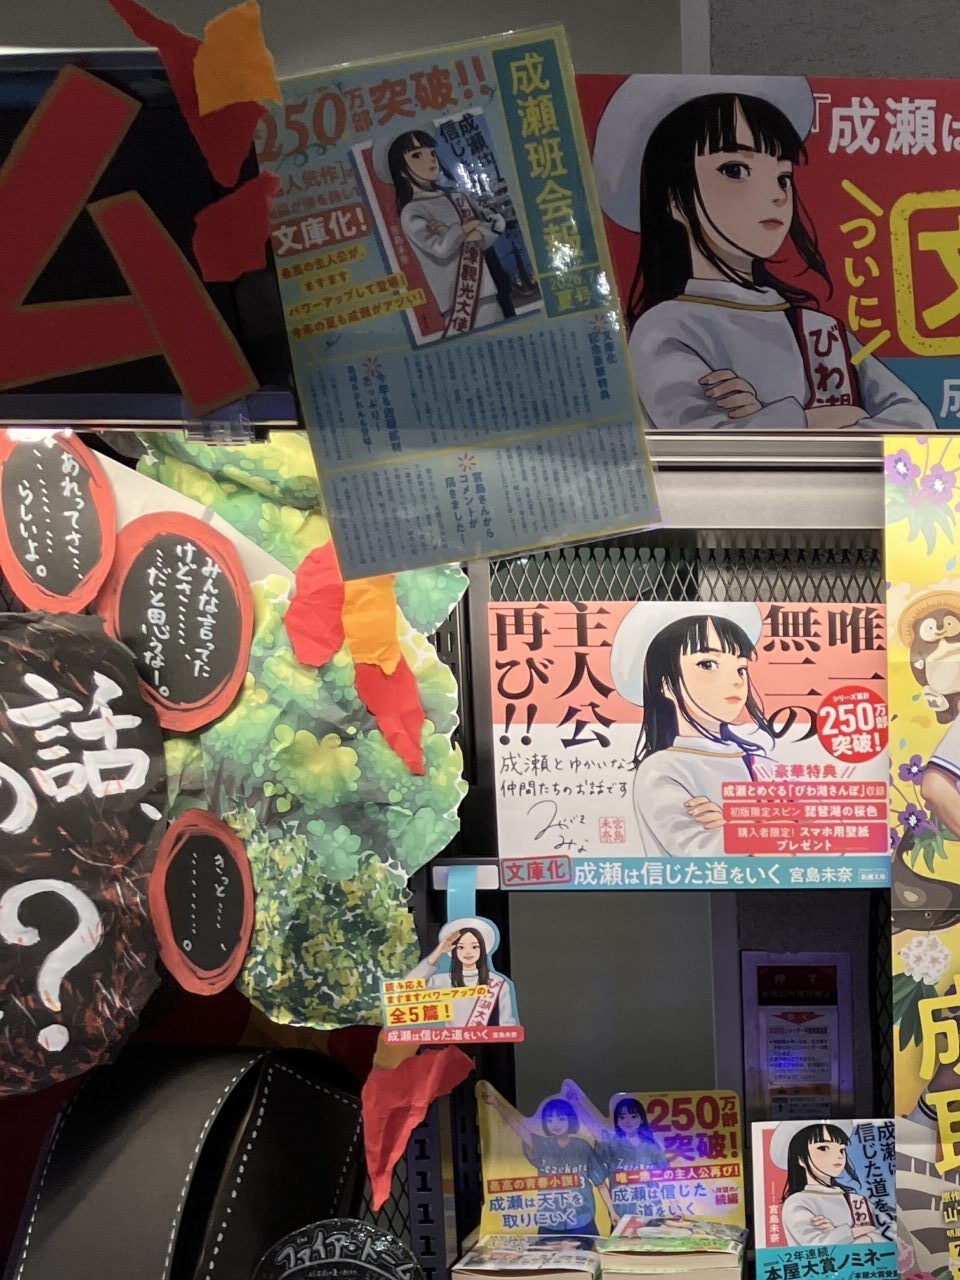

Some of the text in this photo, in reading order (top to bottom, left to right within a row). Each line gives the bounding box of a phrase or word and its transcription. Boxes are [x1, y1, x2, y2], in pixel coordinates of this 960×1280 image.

[840, 218, 882, 331] ついに
[553, 601, 617, 749] 主人公
[763, 604, 822, 744] 無二の
[574, 861, 780, 887] 成瀬は信じた道をいく
[789, 867, 853, 883] 宮島未奈
